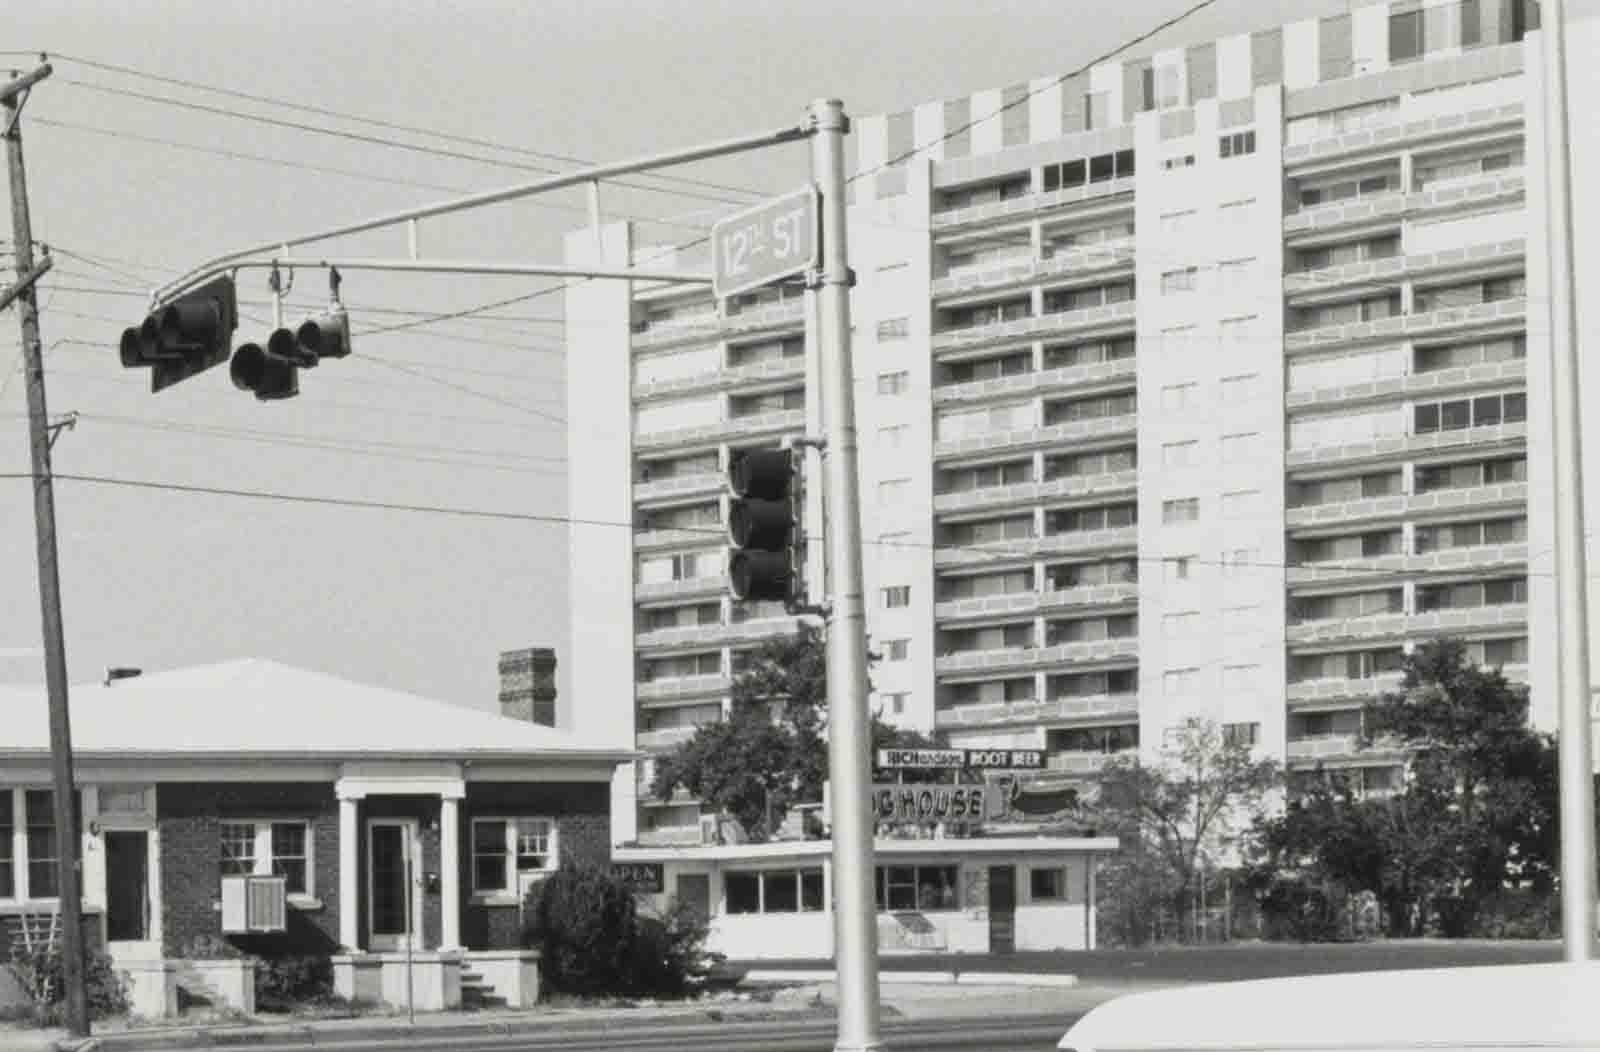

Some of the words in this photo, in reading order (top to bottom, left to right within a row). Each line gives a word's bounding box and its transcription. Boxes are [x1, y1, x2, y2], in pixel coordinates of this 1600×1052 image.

[773, 207, 805, 258] ST
[970, 751, 1007, 767] ROOT
[1012, 751, 1041, 767] BEER
[900, 788, 982, 817] HOUSE
